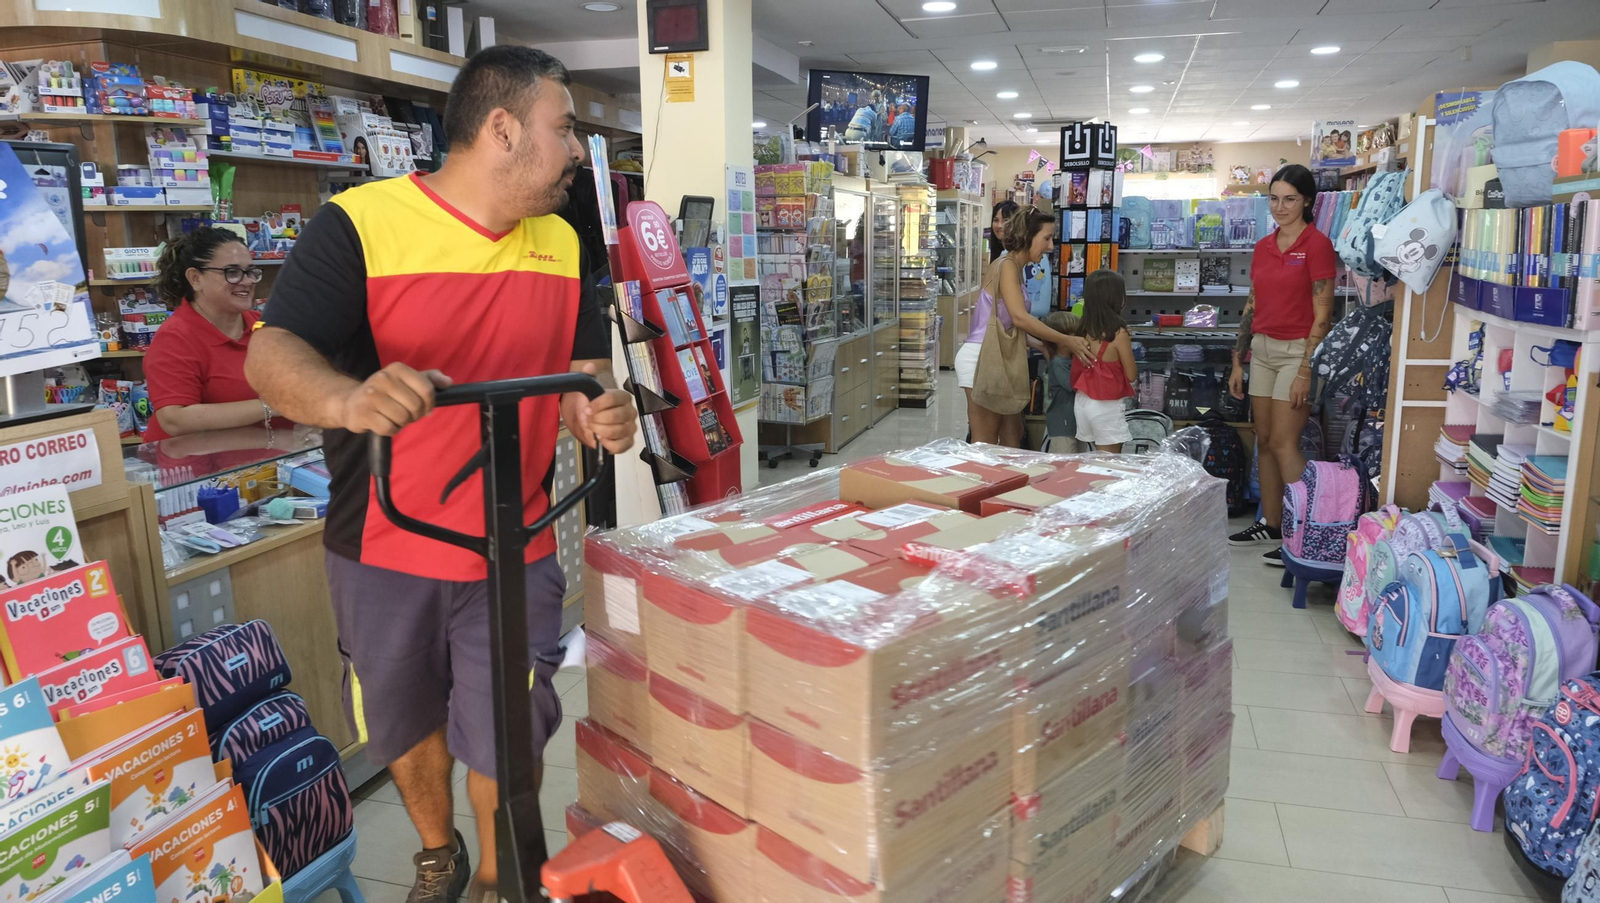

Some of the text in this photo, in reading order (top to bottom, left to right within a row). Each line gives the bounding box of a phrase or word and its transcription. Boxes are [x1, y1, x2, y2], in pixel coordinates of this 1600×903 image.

[26, 433, 87, 460] CORREO
[52, 529, 66, 547] 4
[8, 581, 83, 619] Vacaciones
[43, 661, 120, 703] Vacaciones
[13, 693, 25, 708] 6
[104, 723, 196, 782] VACACIONES 2
[84, 799, 96, 814] 5
[226, 799, 235, 813] 4
[126, 871, 137, 887] 5
